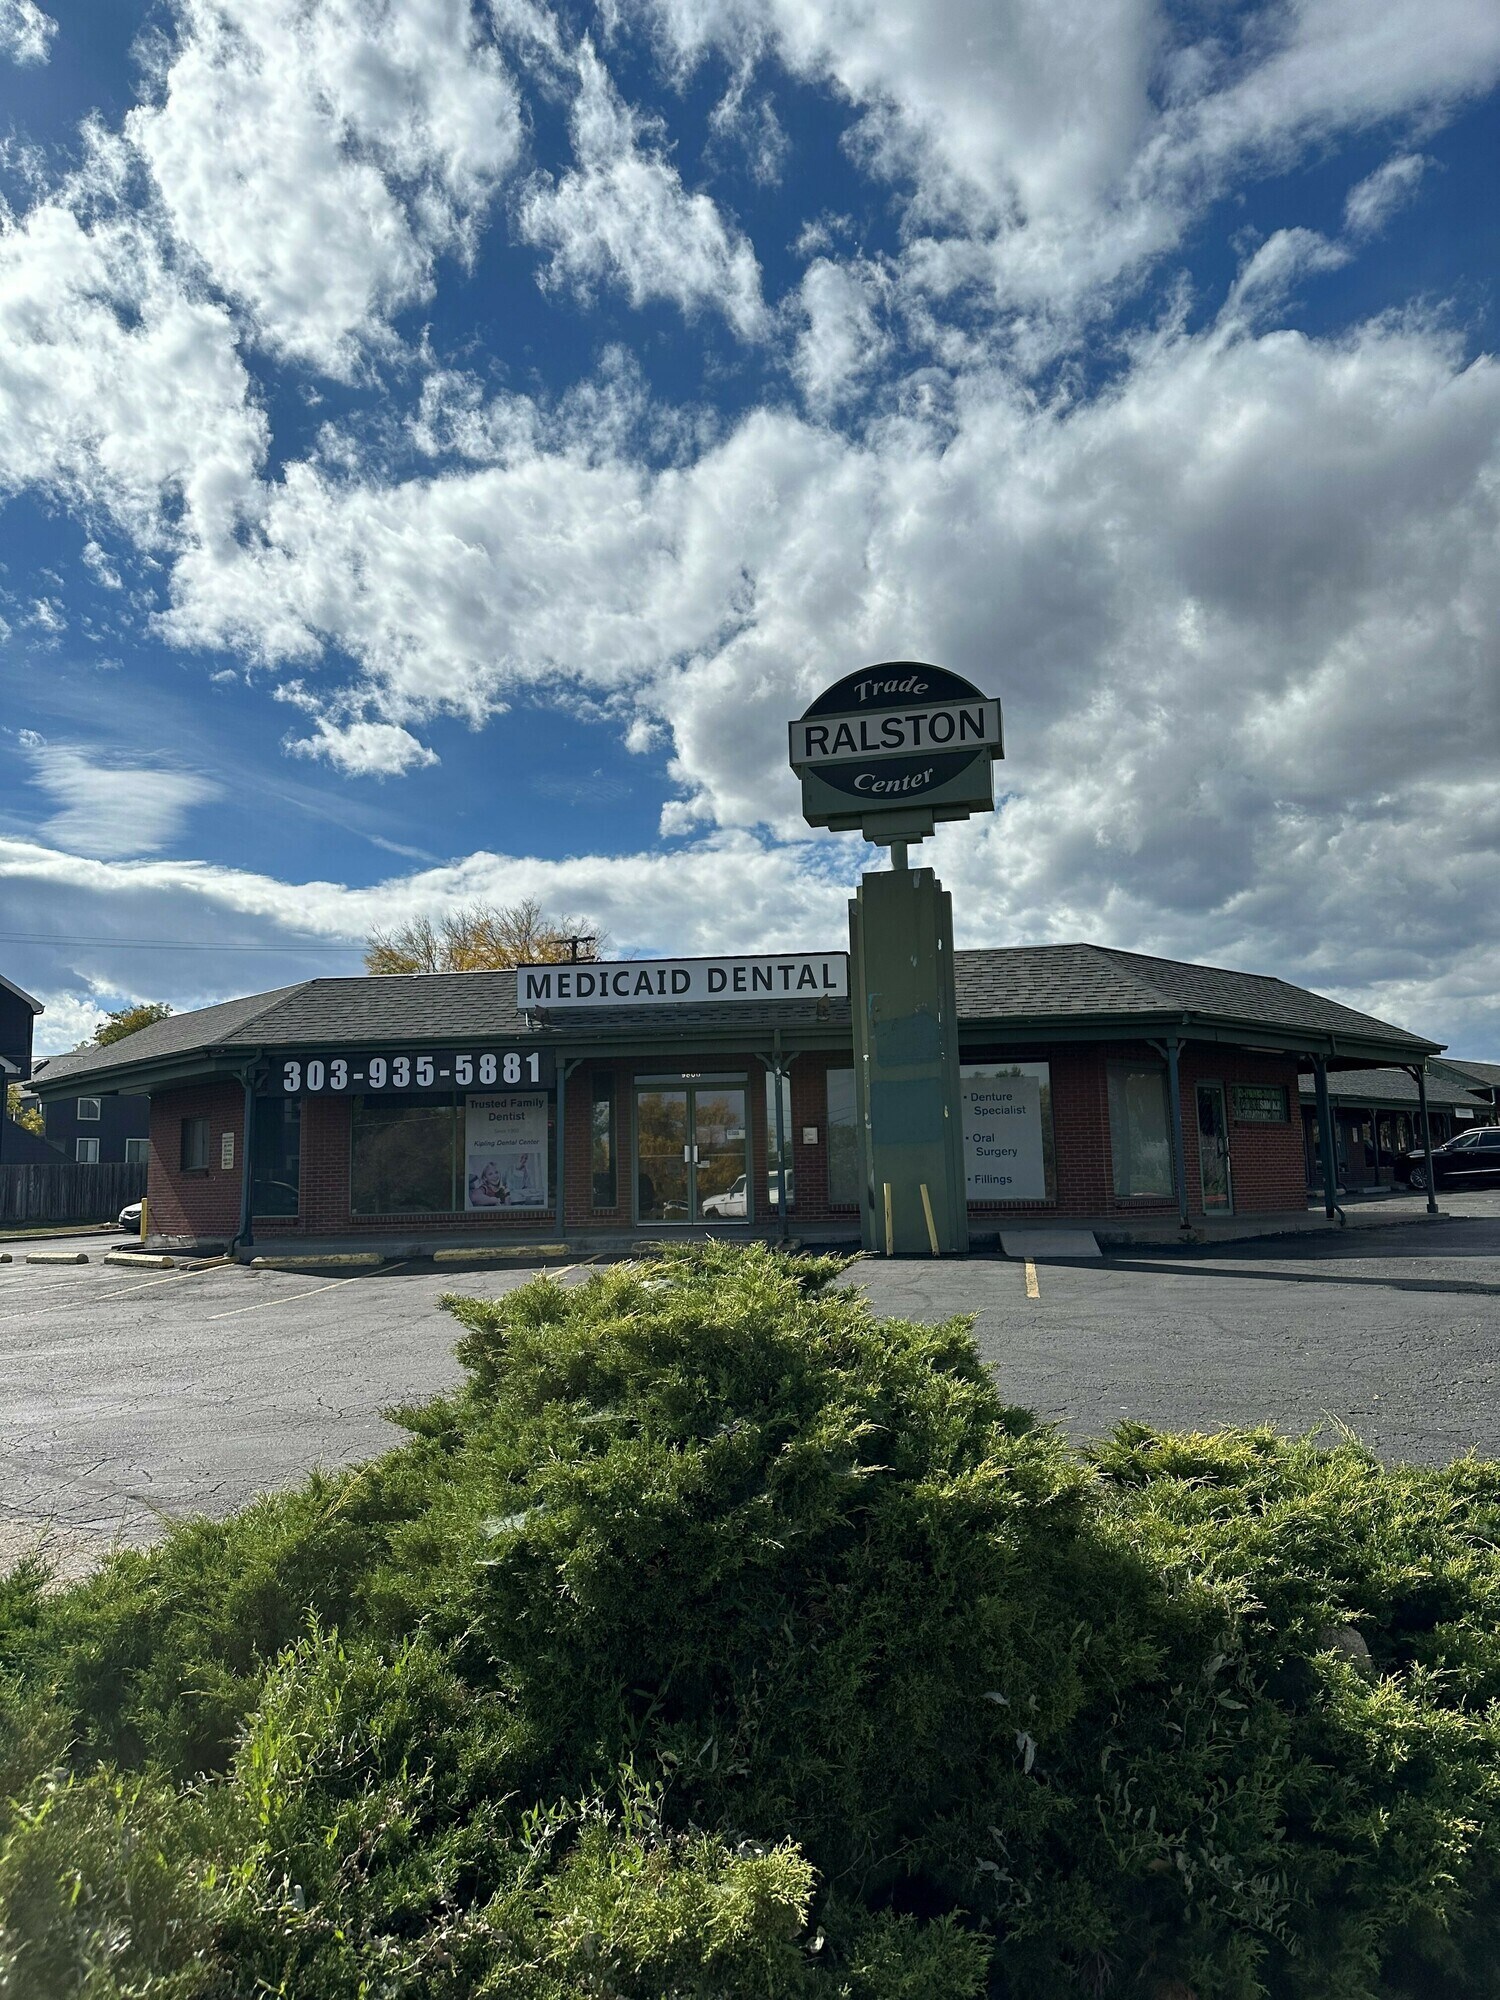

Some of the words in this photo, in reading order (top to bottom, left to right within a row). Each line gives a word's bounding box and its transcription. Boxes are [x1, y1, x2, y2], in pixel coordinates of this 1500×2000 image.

[854, 675, 929, 703] Trade
[805, 707, 985, 757] RALSTON
[854, 767, 934, 793] Center
[526, 969, 691, 999] MEDICAID
[707, 963, 837, 993] DENTAL
[283, 1052, 540, 1092] 303-935-5881
[970, 1092, 1013, 1102] Denture
[470, 1099, 507, 1109] Trusted
[510, 1098, 544, 1108] Family
[974, 1105, 1026, 1116] Specialist
[488, 1112, 525, 1121] Dentist
[972, 1133, 995, 1143] Oral
[976, 1146, 1018, 1158] Surgery
[974, 1174, 1013, 1185] Fillings
